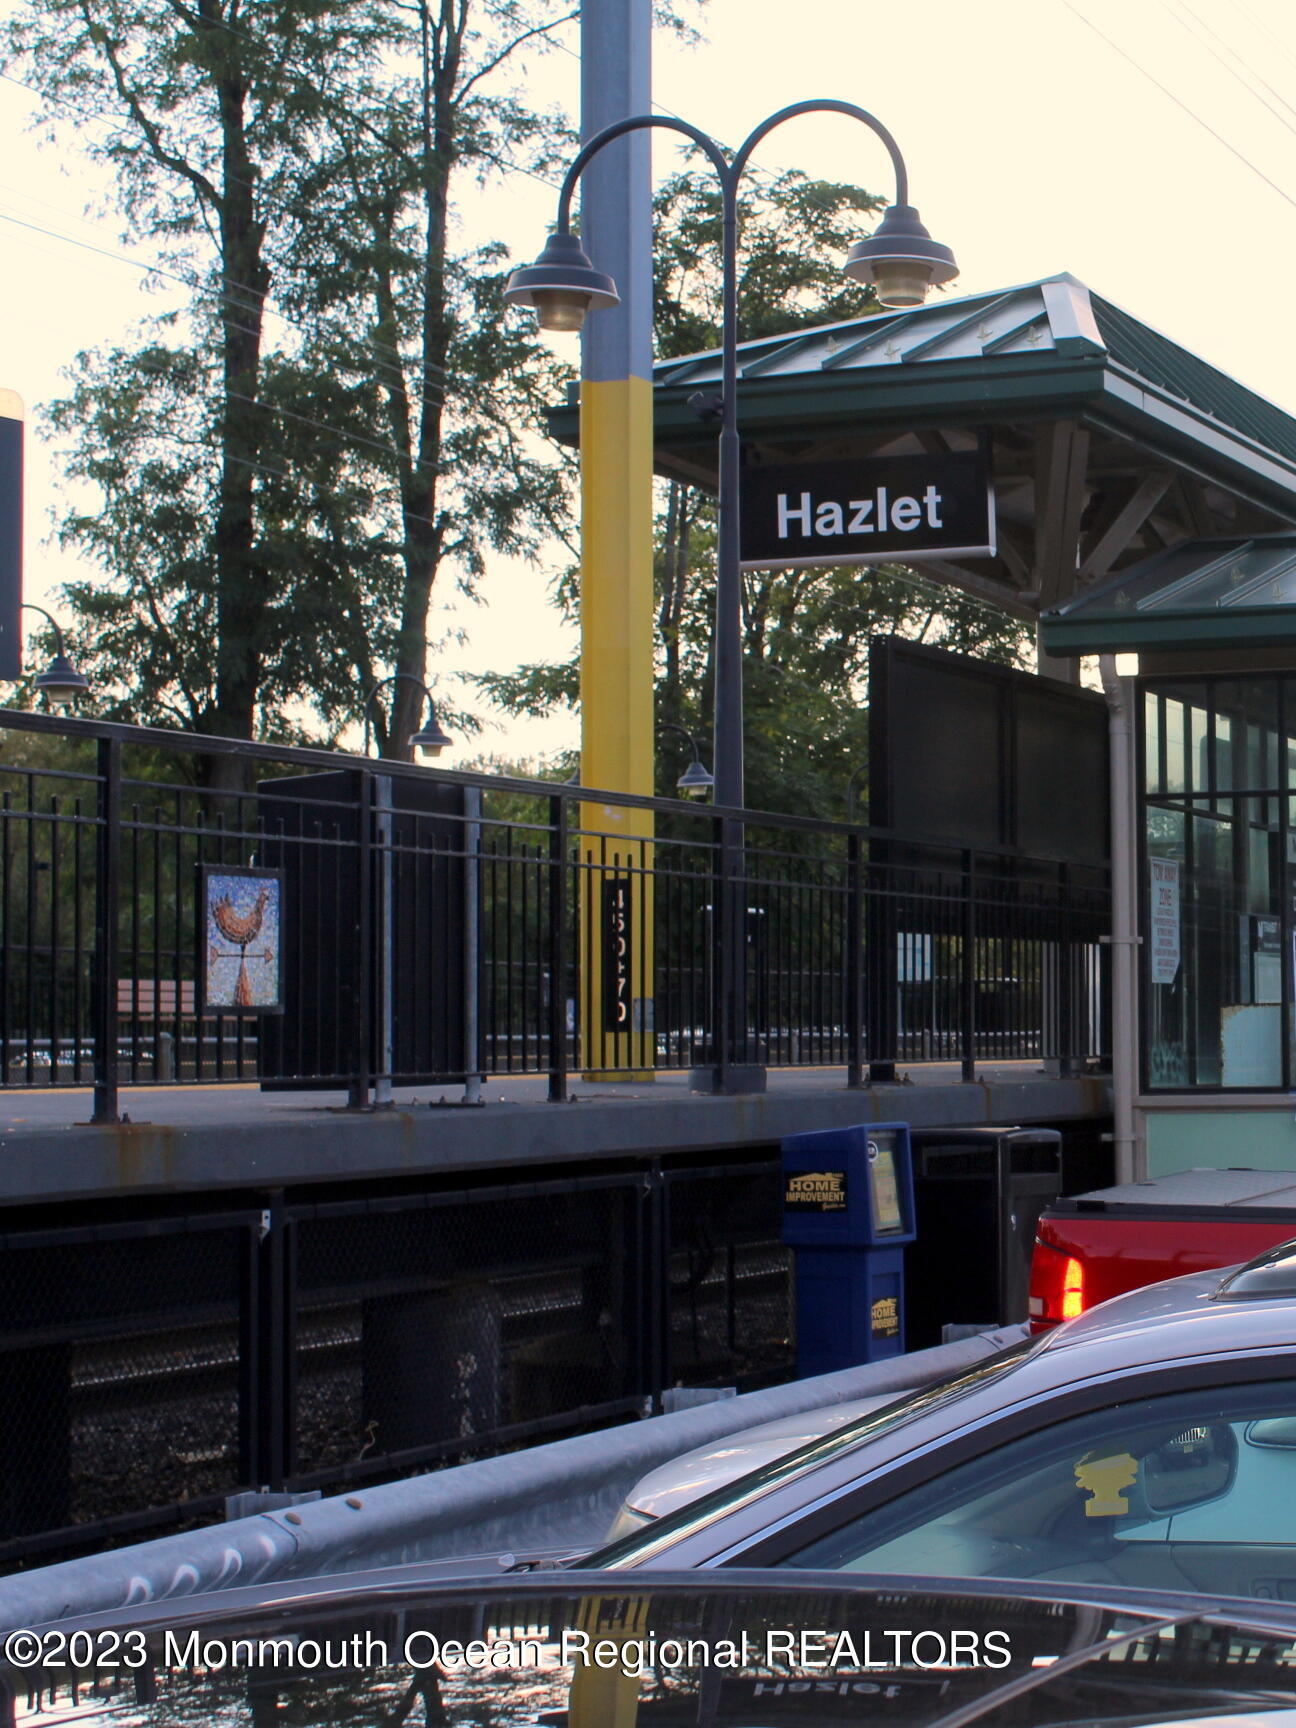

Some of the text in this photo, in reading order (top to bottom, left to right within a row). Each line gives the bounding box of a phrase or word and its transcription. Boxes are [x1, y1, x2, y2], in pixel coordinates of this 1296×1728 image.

[777, 486, 943, 538] Hazlet
[790, 1181, 840, 1191] HOME
[786, 1191, 845, 1202] IMPROVEMENT
[872, 1305, 896, 1319] HOME
